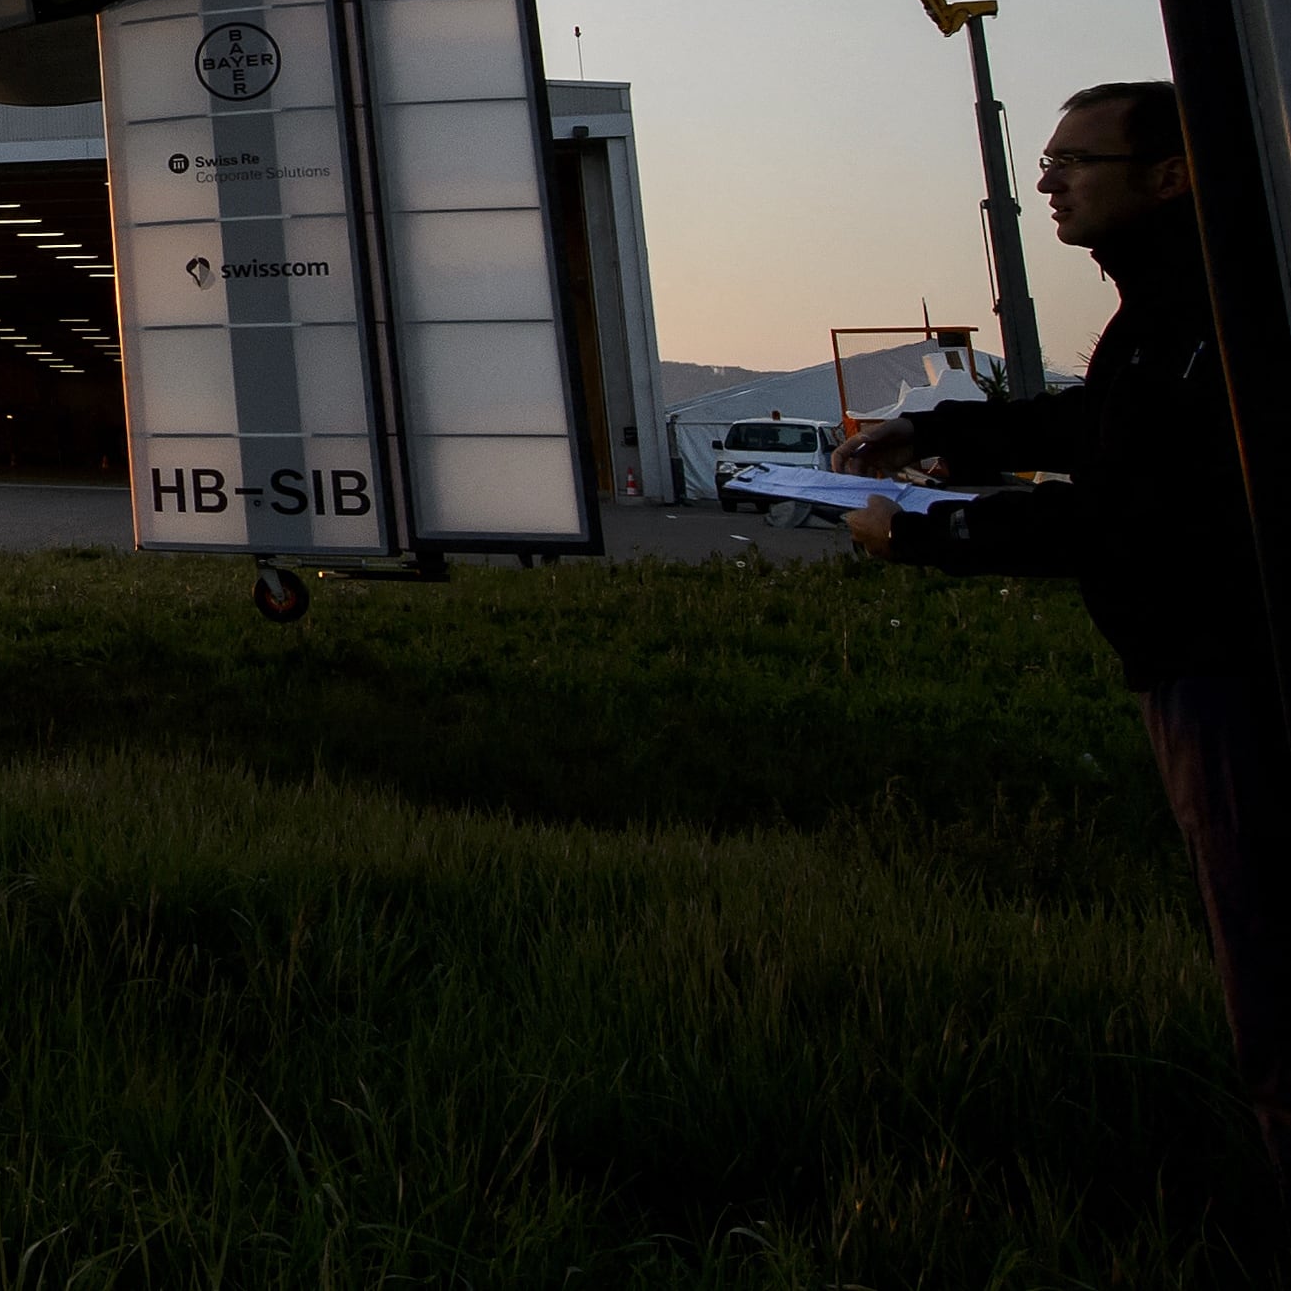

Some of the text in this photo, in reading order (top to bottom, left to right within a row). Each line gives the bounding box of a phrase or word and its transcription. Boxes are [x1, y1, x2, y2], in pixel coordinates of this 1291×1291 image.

[202, 53, 274, 71] BAYER
[195, 153, 260, 168] Swiss Re
[196, 166, 331, 184] Corporate Solutions
[221, 259, 330, 279] swisscom
[151, 468, 371, 516] HB-SIB
